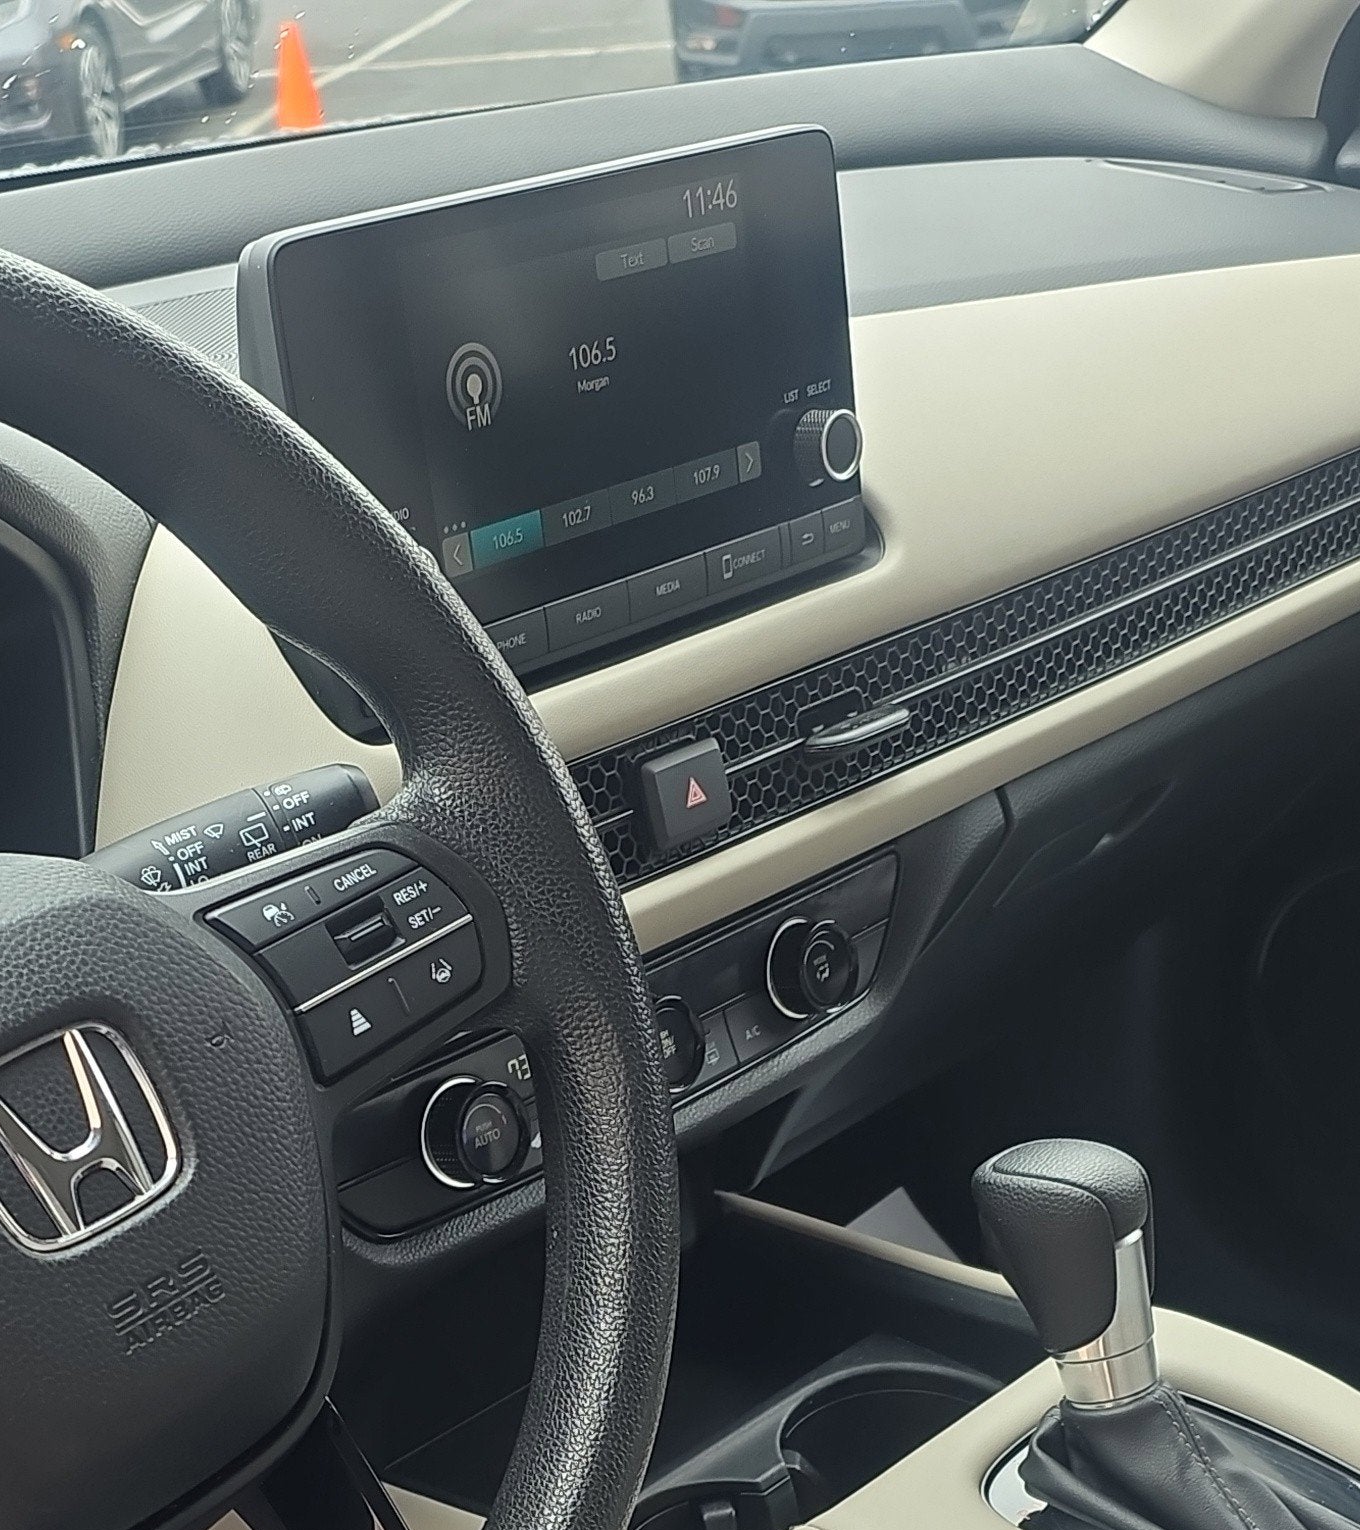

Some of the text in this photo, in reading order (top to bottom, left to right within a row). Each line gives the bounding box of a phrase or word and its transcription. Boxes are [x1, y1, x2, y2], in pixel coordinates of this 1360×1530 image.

[683, 178, 738, 218] 11:46
[690, 236, 715, 252] Scan
[620, 252, 645, 269] Text
[568, 336, 617, 371] 106.5
[577, 375, 610, 393] Morgan
[783, 379, 832, 404] LIST SELECT
[466, 402, 492, 431] FM
[693, 464, 721, 486] 107.9
[631, 485, 655, 506] 96.3
[561, 504, 591, 528] 102.7
[829, 519, 851, 535] MENU
[492, 527, 524, 550] 106.5
[732, 548, 766, 570] CONNECT
[655, 579, 681, 597] MEDIA
[575, 606, 602, 625] RADIO
[497, 632, 527, 651] PHONE
[282, 790, 311, 811] OFF
[291, 811, 318, 832] INT
[164, 825, 198, 847] MIST
[176, 841, 205, 861] OFF
[246, 842, 278, 863] REAR
[183, 856, 209, 877] INT
[333, 863, 378, 892] CANCEL
[392, 880, 428, 906] RES/+
[474, 1128, 501, 1150] AUTO
